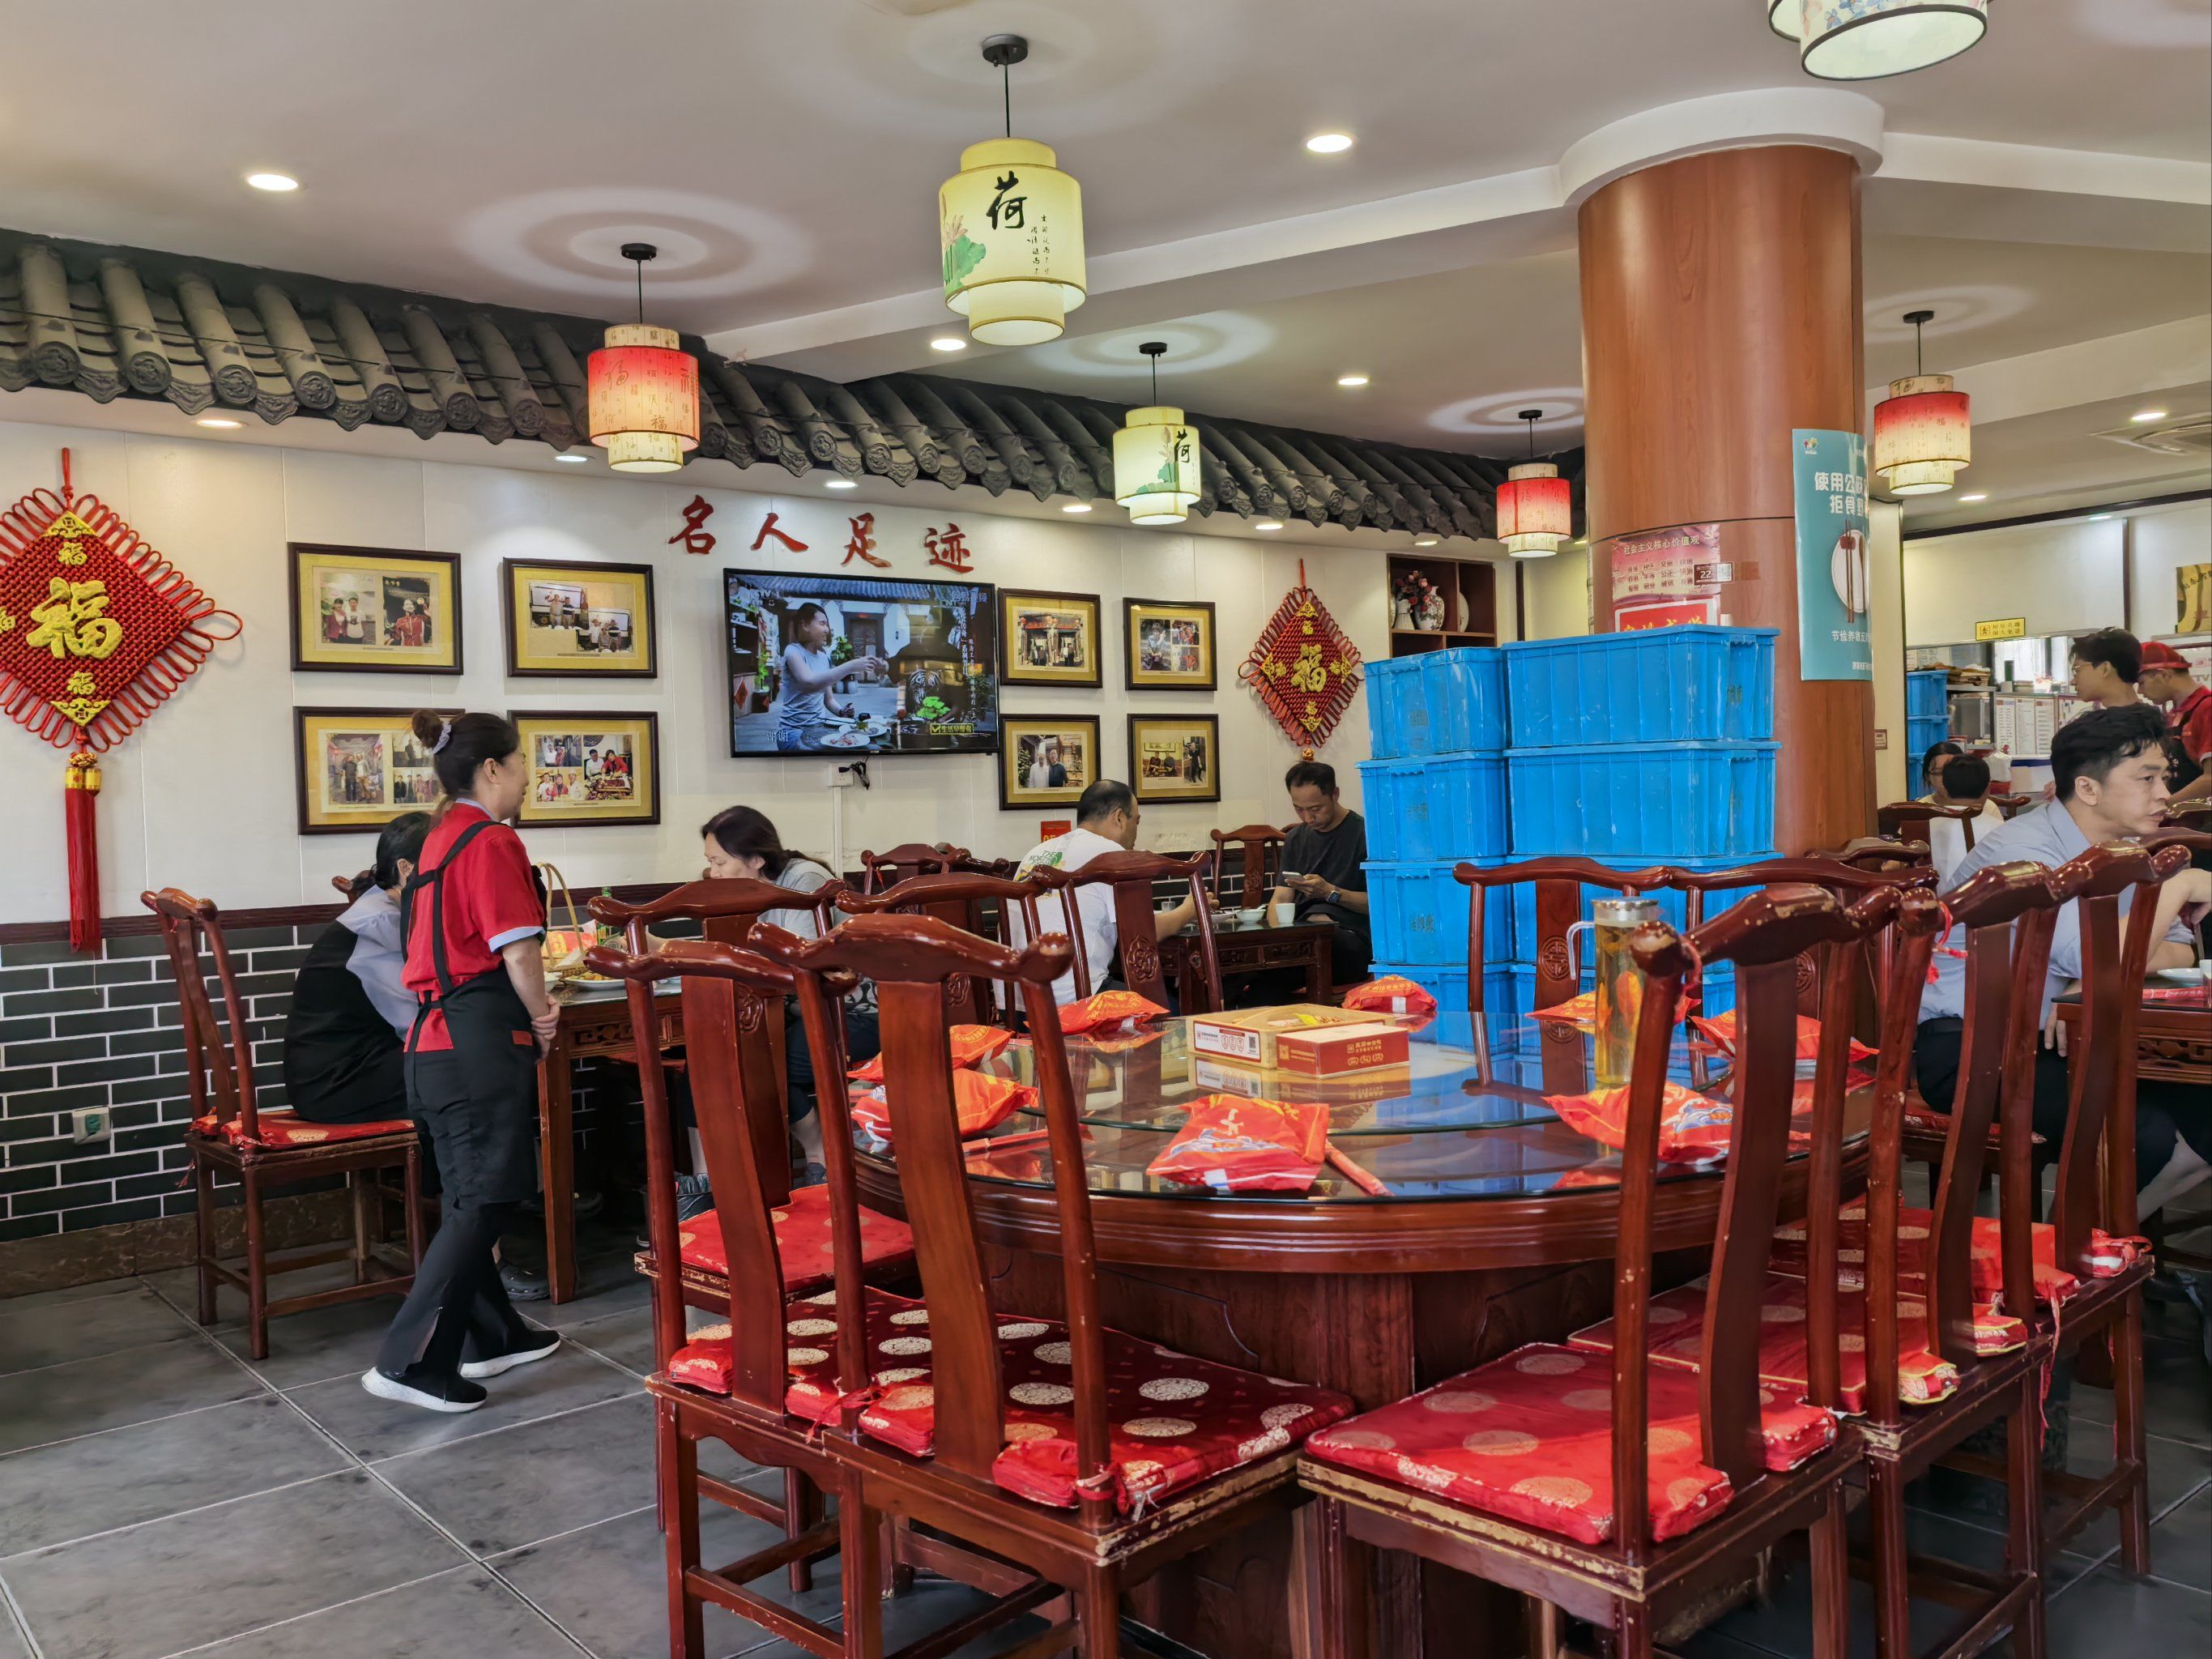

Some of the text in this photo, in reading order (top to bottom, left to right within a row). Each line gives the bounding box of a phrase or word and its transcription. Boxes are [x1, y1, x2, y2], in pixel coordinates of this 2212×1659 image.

[986, 170, 1028, 230] 荷
[651, 414, 667, 430] 福
[1174, 428, 1191, 463] 荷
[668, 494, 974, 574] 名人足迹
[1623, 535, 1700, 555] 社会主义核心价值观
[58, 541, 87, 565] 福
[1660, 569, 1673, 578] 公正
[1700, 570, 1711, 579] 22
[26, 576, 123, 660] 福
[1289, 644, 1328, 693] 福
[67, 671, 96, 695] 福
